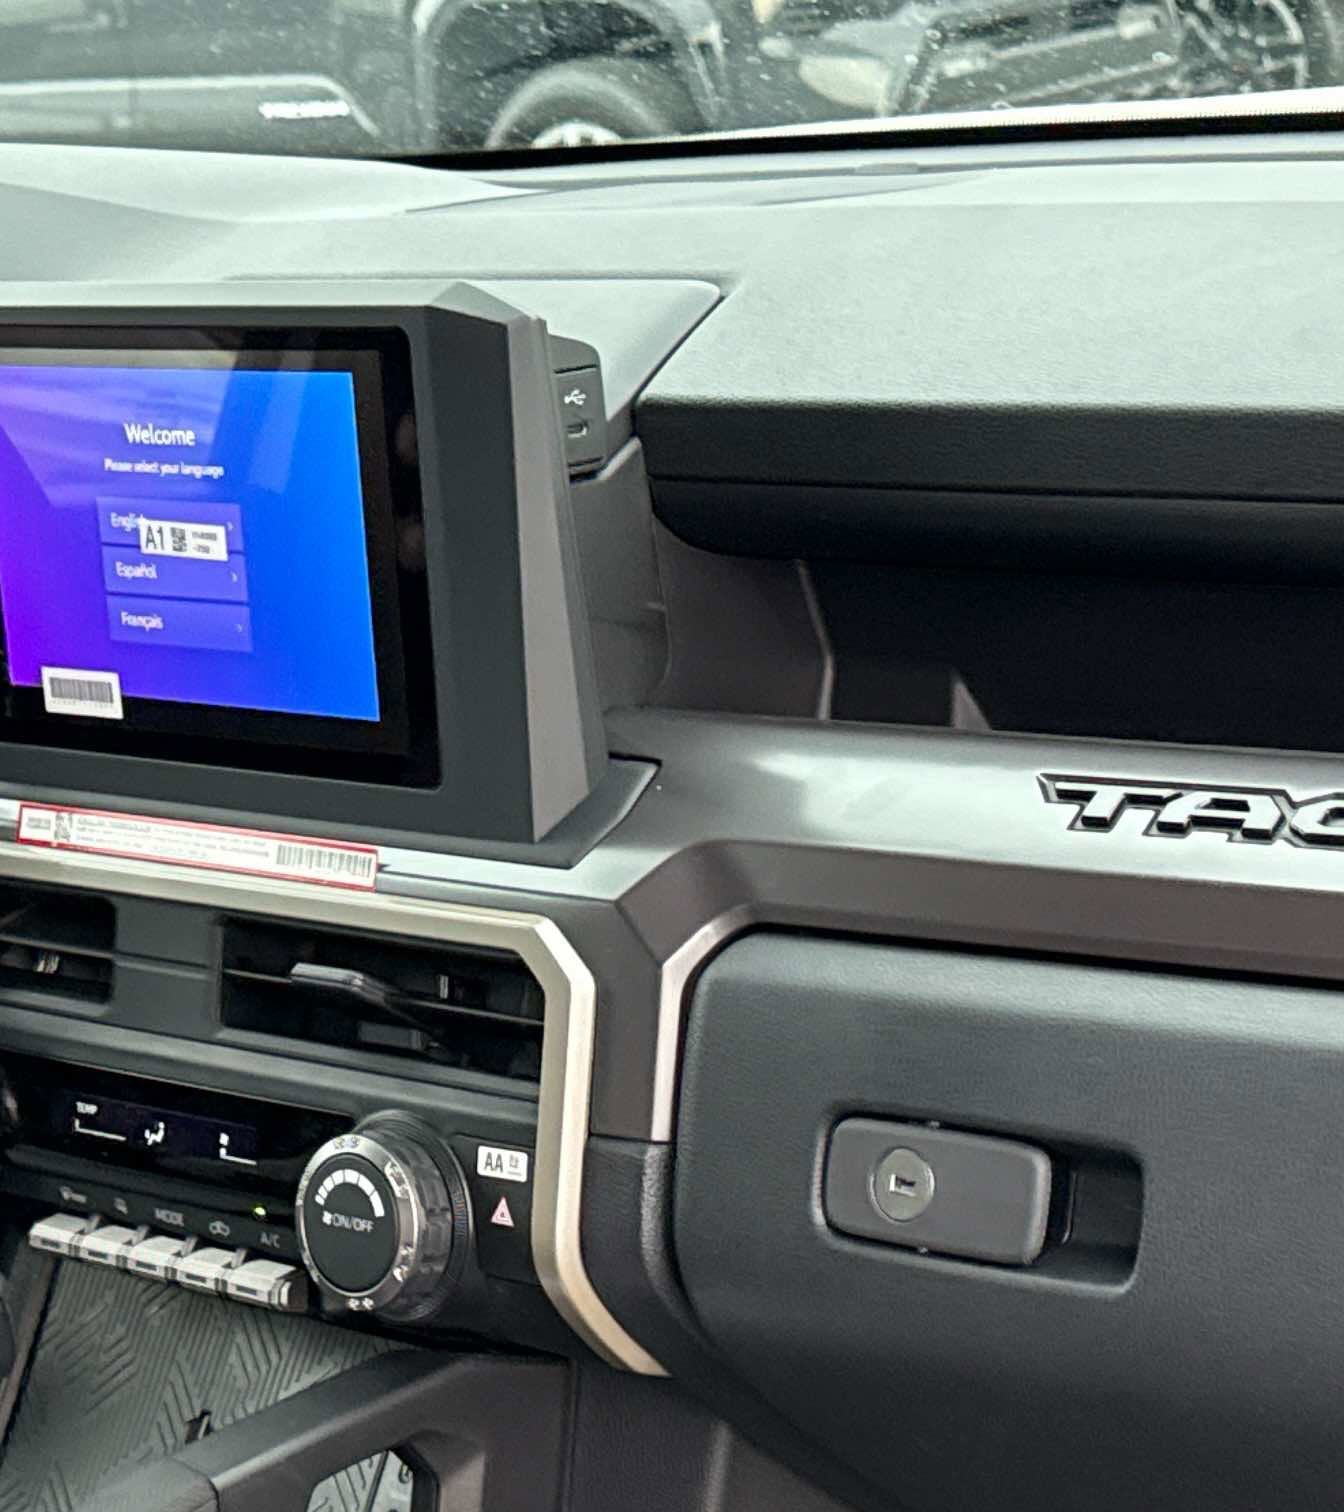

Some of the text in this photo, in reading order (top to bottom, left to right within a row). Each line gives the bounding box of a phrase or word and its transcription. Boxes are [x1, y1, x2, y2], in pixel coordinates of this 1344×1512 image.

[123, 422, 196, 446] Welcome
[104, 457, 132, 472] Please
[180, 461, 225, 479] language
[145, 525, 165, 550] A1
[484, 1151, 504, 1174] AA
[332, 1213, 374, 1233] ON/OFF
[260, 1232, 282, 1249] A/C
